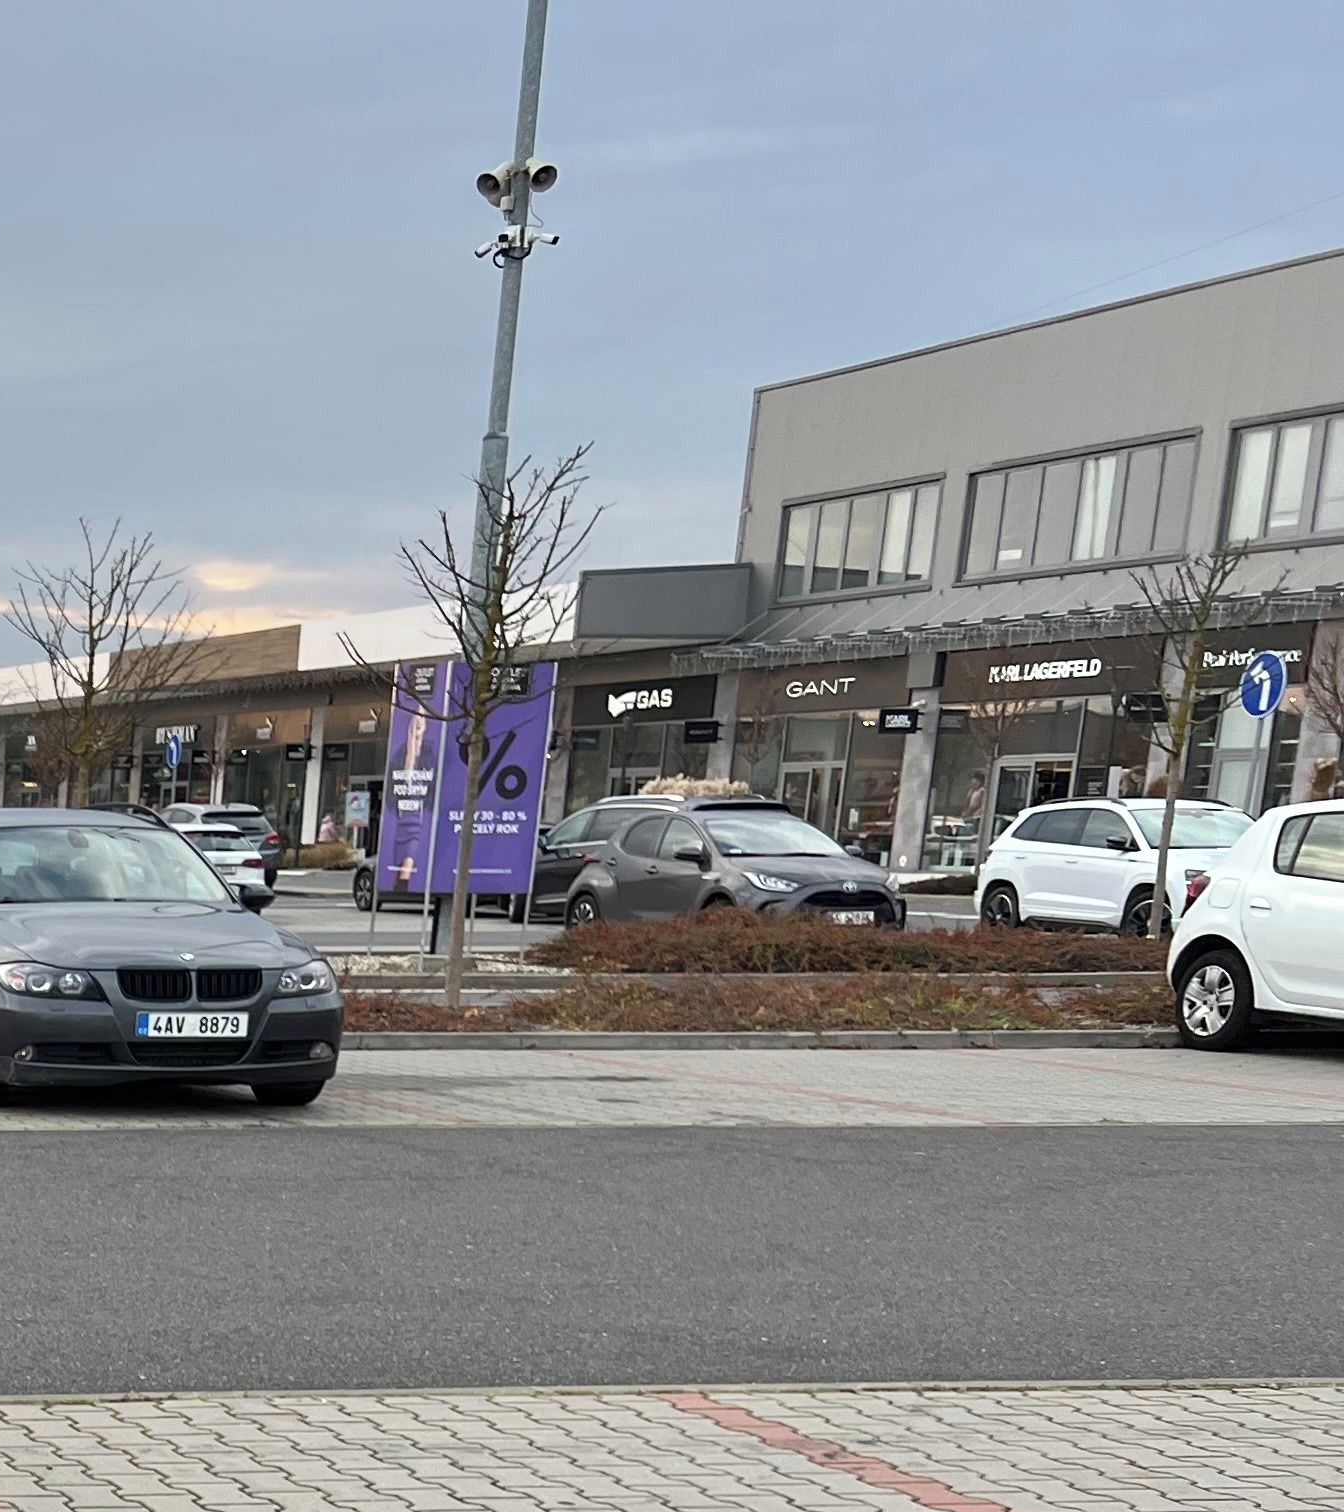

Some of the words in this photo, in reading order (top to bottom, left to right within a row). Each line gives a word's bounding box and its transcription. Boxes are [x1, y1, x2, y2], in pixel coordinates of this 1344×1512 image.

[1023, 658, 1102, 682] LAGERFELD
[785, 677, 856, 698] GANT
[636, 688, 673, 710] GAS
[152, 1016, 186, 1034] 4AV
[199, 1016, 241, 1035] 8879
